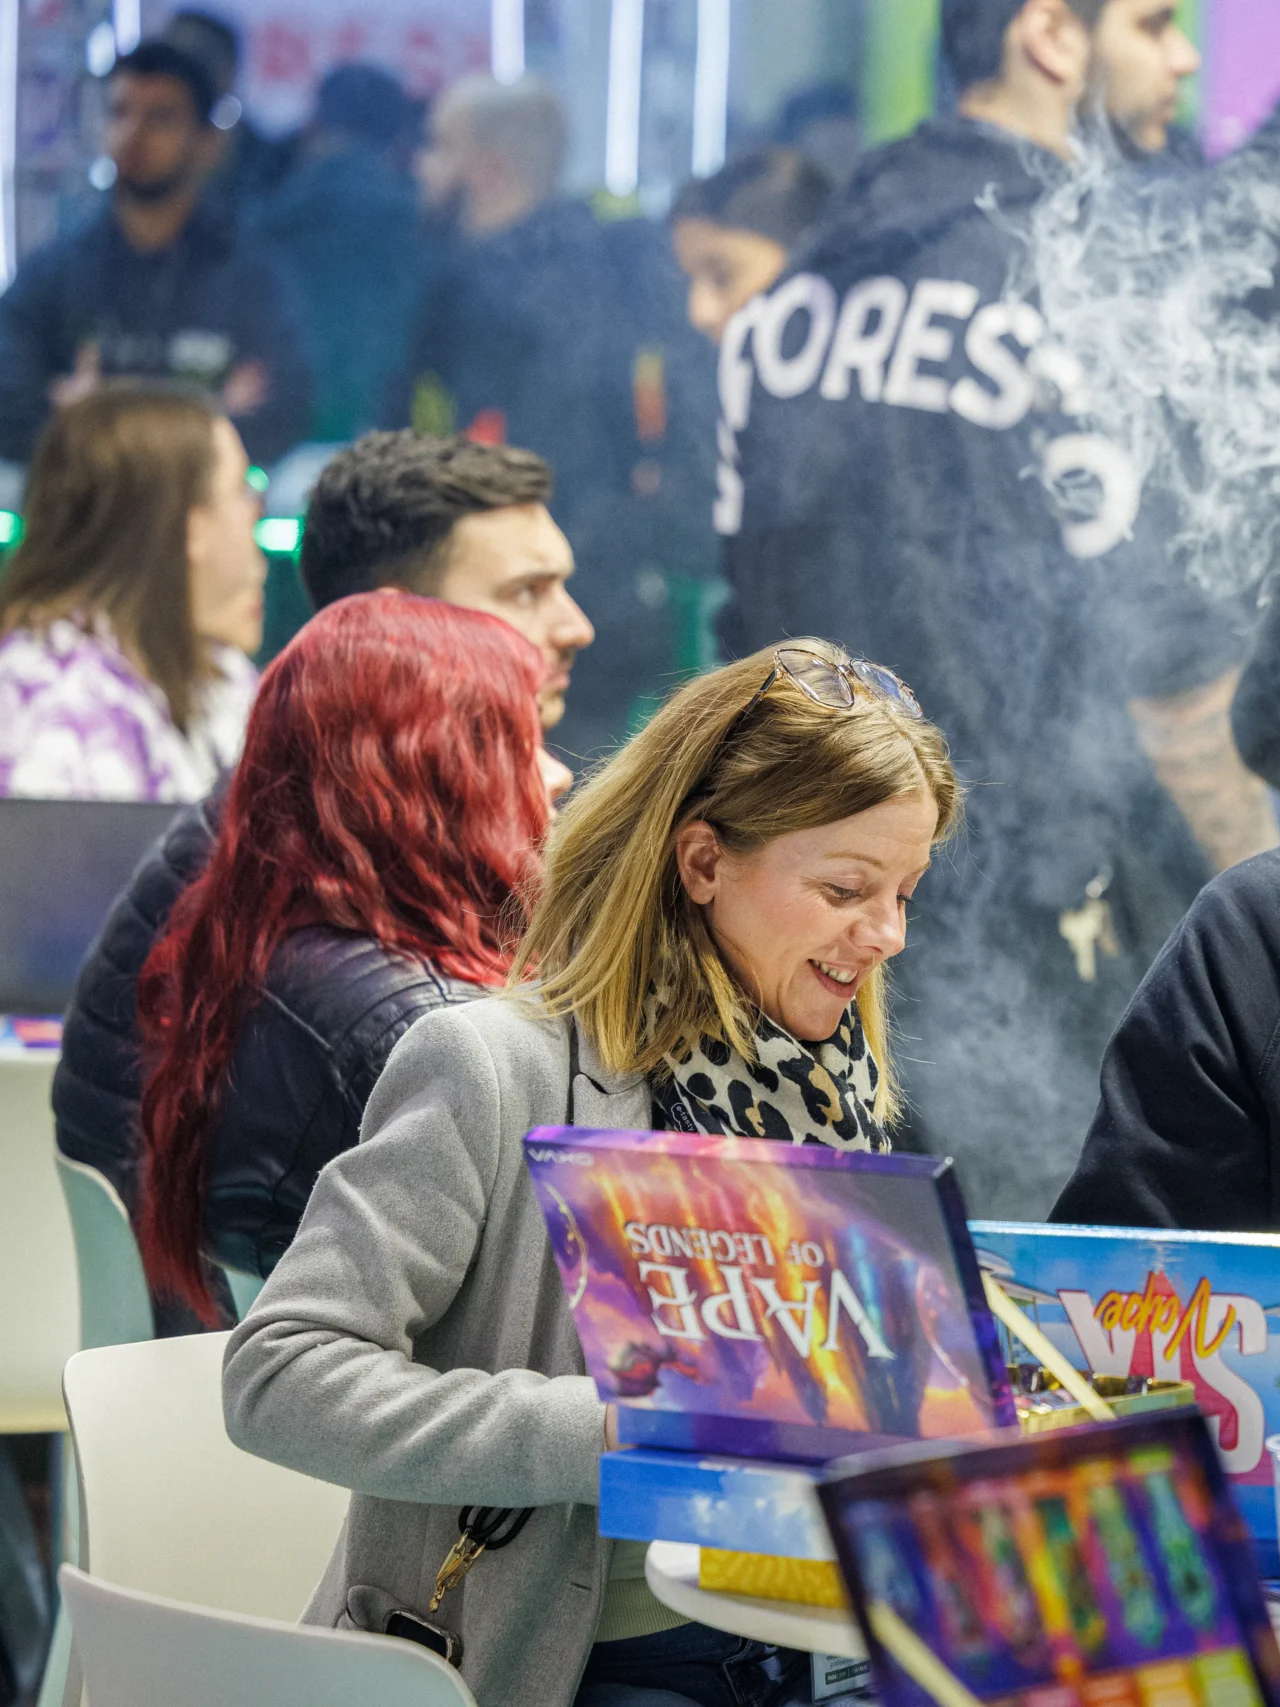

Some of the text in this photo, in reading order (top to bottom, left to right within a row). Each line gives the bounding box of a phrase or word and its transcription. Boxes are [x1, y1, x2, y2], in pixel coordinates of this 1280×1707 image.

[675, 1105, 695, 1132] e-tasty
[624, 1221, 826, 1269] OF LEGENDS
[638, 1260, 898, 1361] VAPE
[1093, 1270, 1237, 1362] Vape
